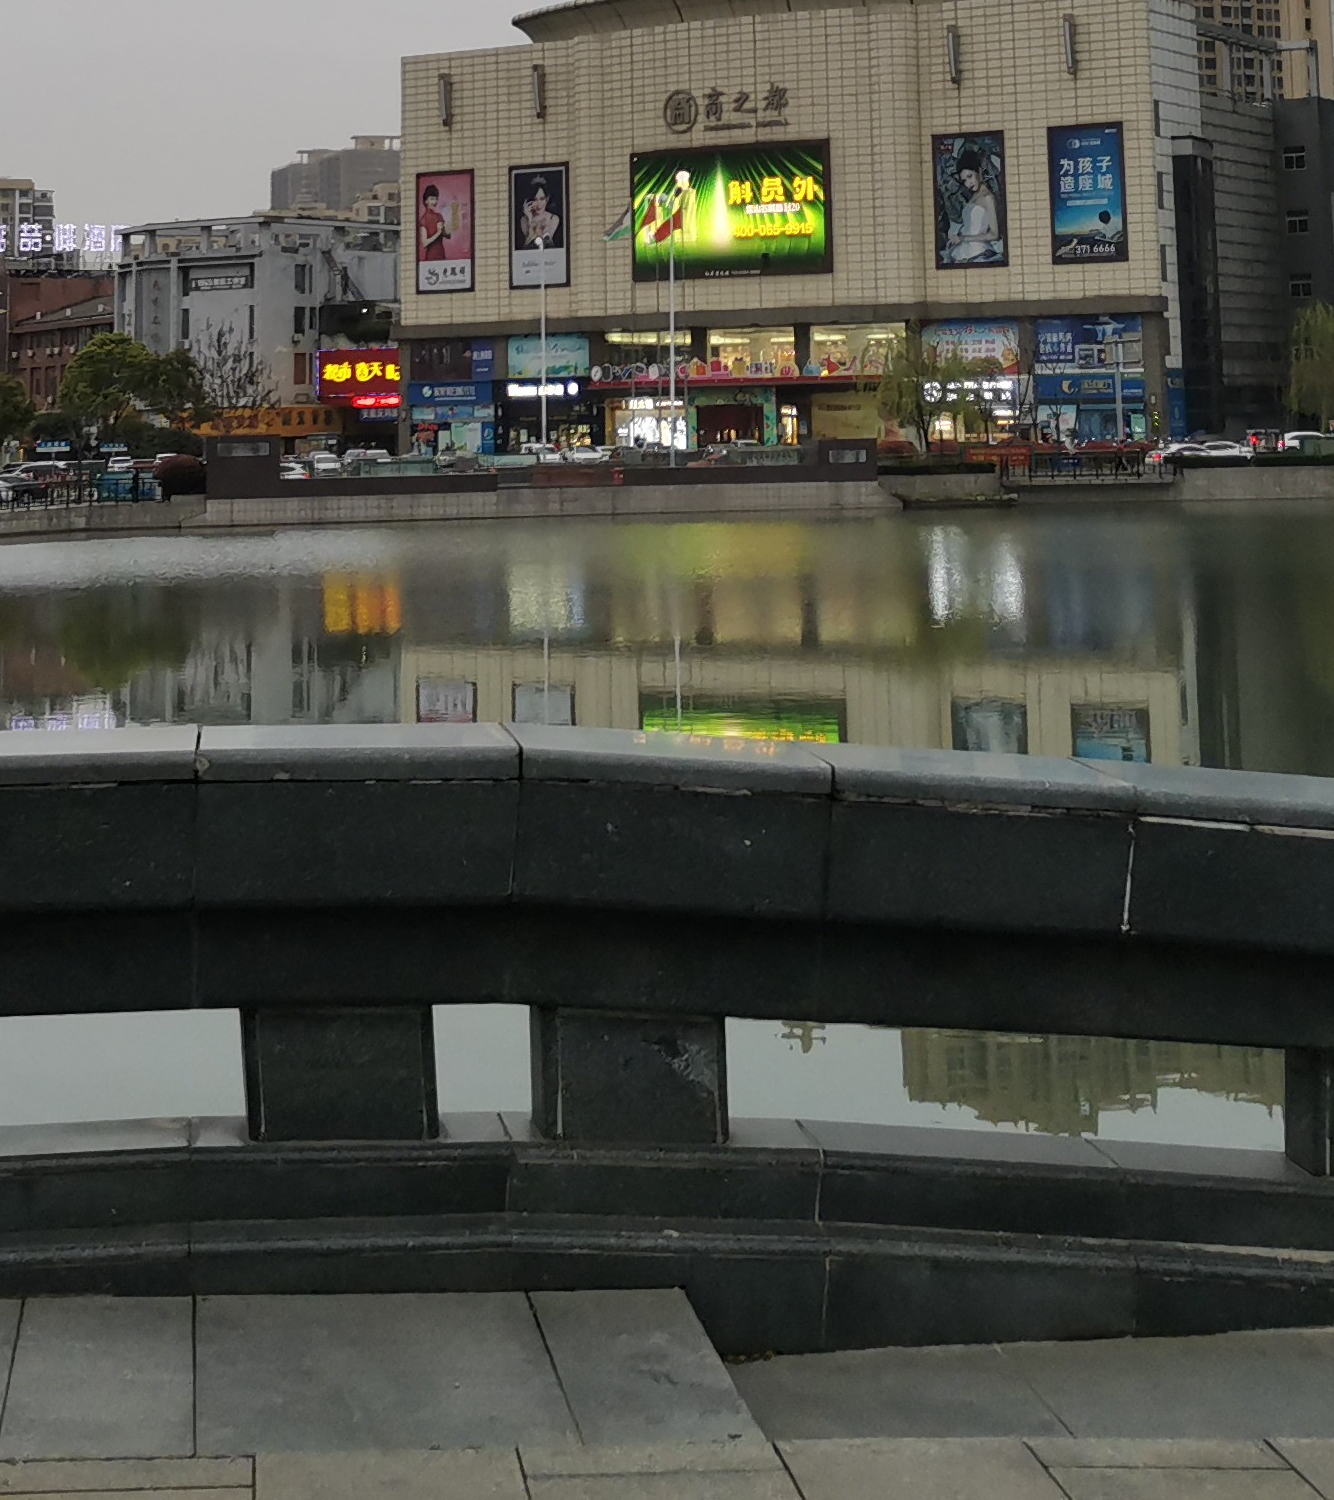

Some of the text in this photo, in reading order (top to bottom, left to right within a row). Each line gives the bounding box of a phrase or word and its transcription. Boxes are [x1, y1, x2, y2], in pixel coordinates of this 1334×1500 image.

[702, 82, 789, 122] 商之都
[1059, 156, 1112, 175] 为孩子
[1060, 174, 1114, 193] 造座城
[1093, 243, 1116, 253] 6666
